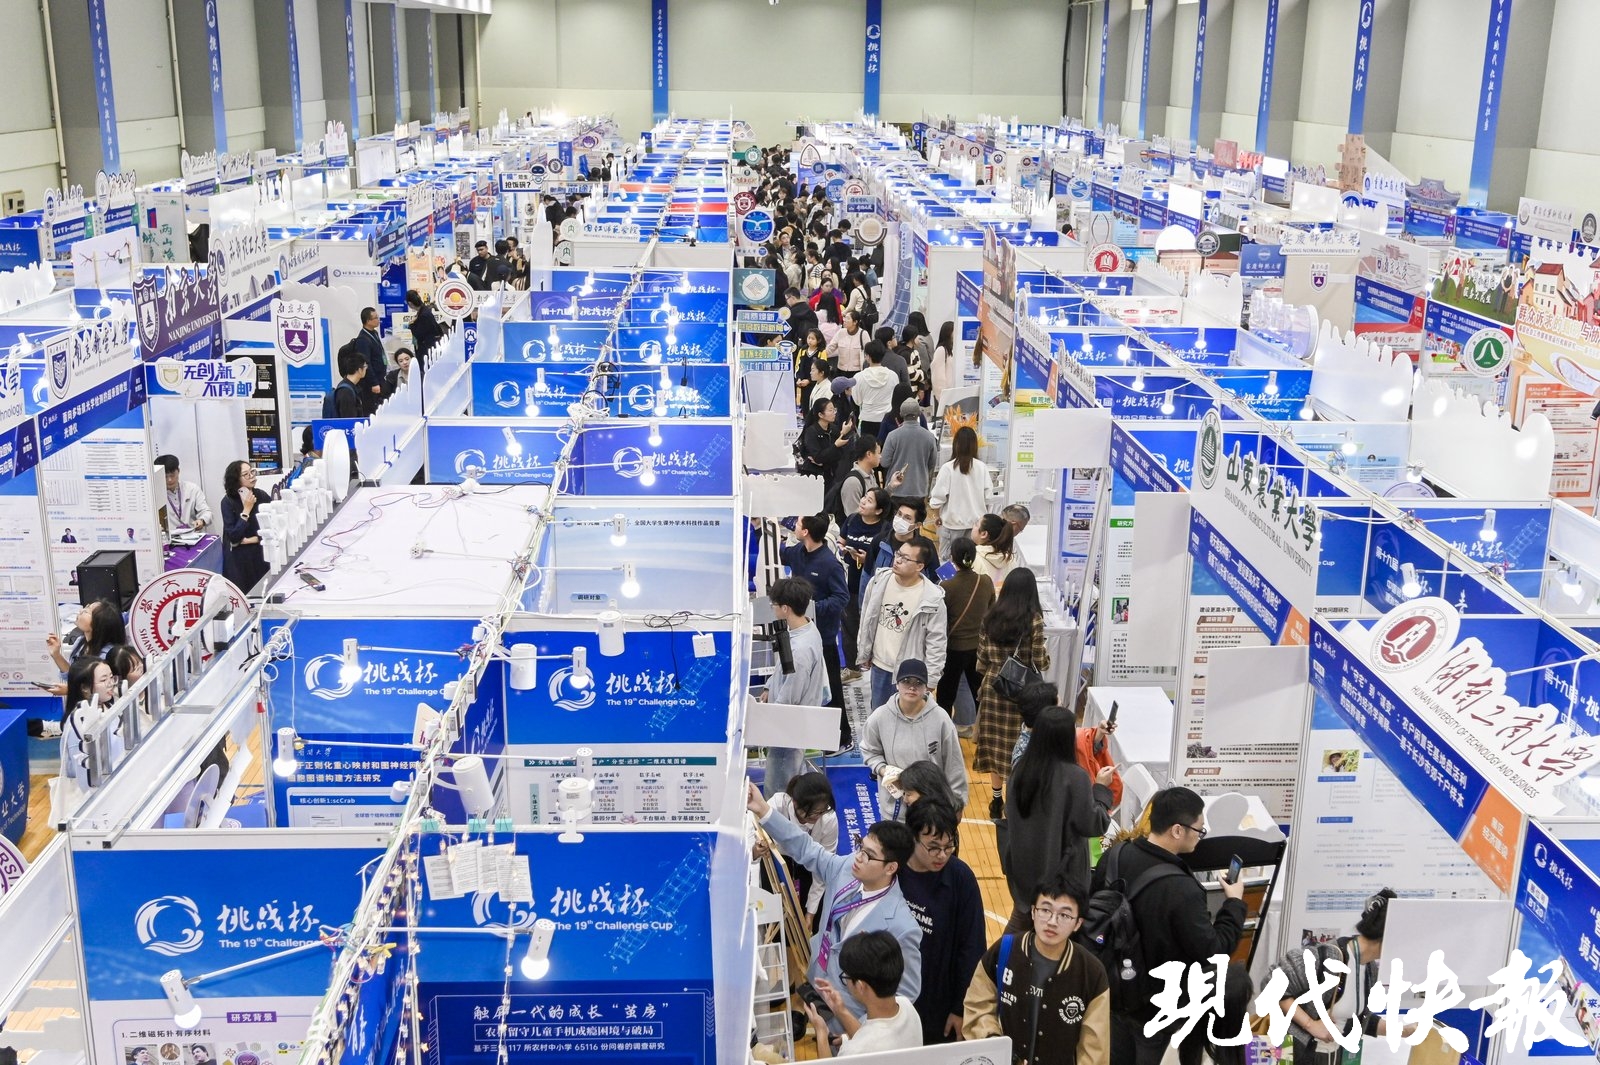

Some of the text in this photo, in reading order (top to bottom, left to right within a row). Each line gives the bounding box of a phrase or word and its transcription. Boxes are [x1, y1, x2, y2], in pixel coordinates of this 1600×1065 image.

[168, 310, 220, 342] NANJING UNIVERSITY
[667, 343, 702, 356] 挑战杯
[651, 449, 698, 468] 挑战杯
[363, 657, 438, 685] 挑战杯
[605, 668, 679, 696] 挑战杯
[364, 687, 380, 696] The
[397, 687, 439, 698] Challenge
[606, 697, 696, 708] The 19th Challenge Cup
[1412, 685, 1430, 706] HUNAN
[1429, 700, 1457, 731] UNIVERSITY
[1463, 733, 1497, 769] TECHNOLOGY
[1496, 761, 1509, 779] AND
[1506, 771, 1540, 800] BUSINESS
[549, 884, 651, 917] 挑战杯
[217, 899, 320, 935] 挑战杯
[575, 919, 593, 931] 19th
[595, 921, 648, 932] Challenge
[652, 921, 673, 932] Cup
[219, 939, 240, 948] The
[244, 937, 262, 948] 19th
[230, 1012, 273, 1023] 研究背景
